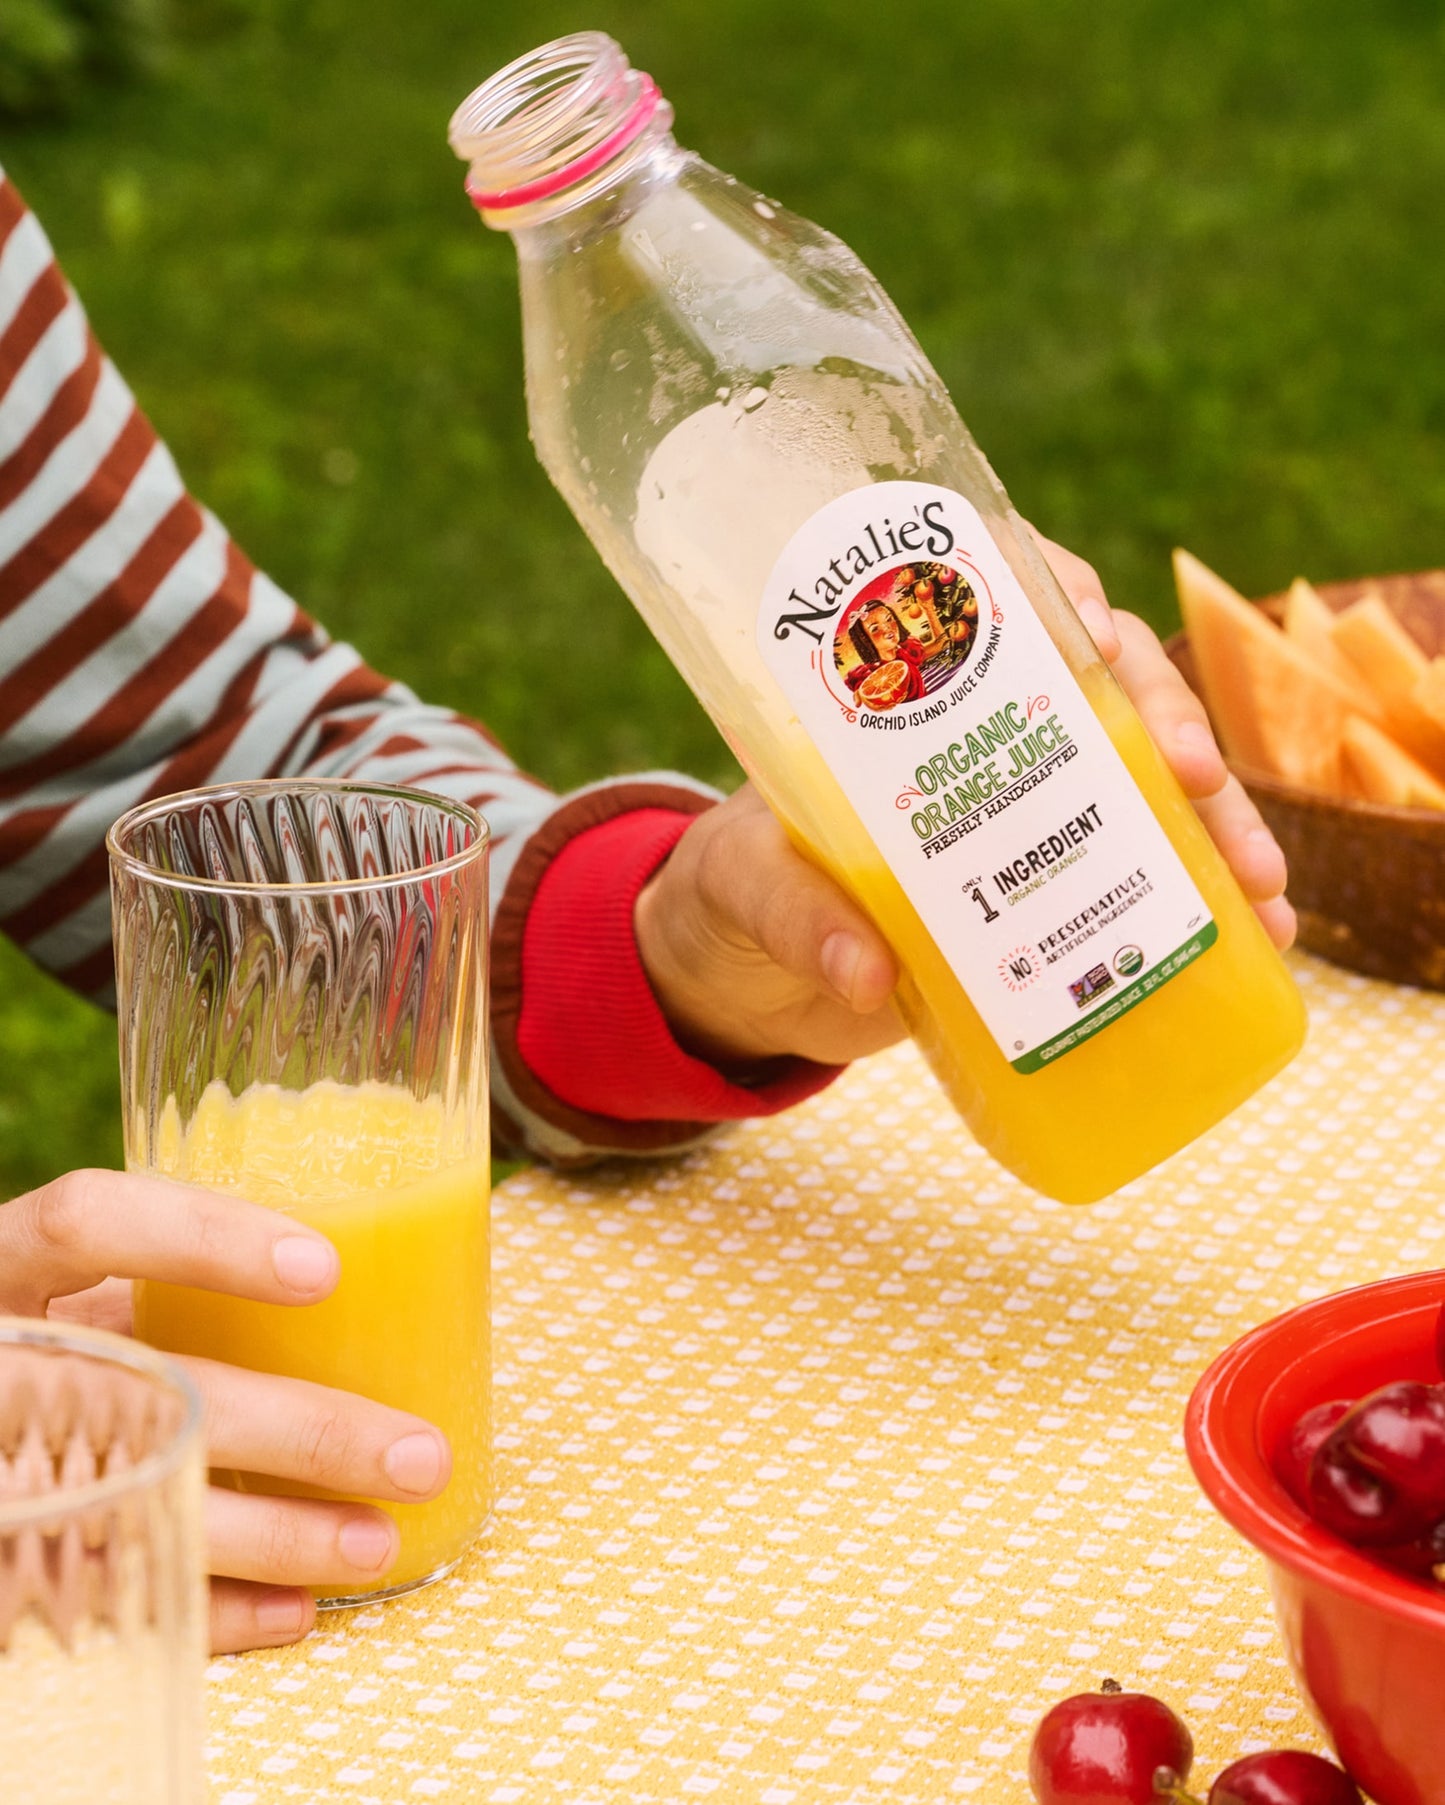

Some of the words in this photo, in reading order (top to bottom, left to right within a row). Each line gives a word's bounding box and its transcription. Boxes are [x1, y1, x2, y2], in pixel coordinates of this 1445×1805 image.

[860, 713, 906, 731] ORCHID
[909, 699, 948, 727] ISLAND
[949, 675, 978, 707] JUICE
[974, 624, 1003, 679] COMPANY
[911, 761, 1007, 840] ORANGE
[1007, 713, 1070, 778] JUICE
[915, 701, 1027, 796] ORGANIC
[922, 814, 983, 860] FRESHLY
[986, 744, 1079, 819] HANDCRAFTED
[961, 876, 983, 893] ONLY
[971, 887, 1000, 924] 1
[992, 803, 1103, 895] INGREDIENT
[1007, 875, 1047, 906] ORGANIC
[1047, 845, 1089, 879] ORANGES
[1037, 867, 1147, 954] PRESERVATIVES
[1045, 926, 1099, 965] ARTIFICIAL
[1098, 881, 1154, 928] INGREDIENTS
[1008, 957, 1032, 982] NO
